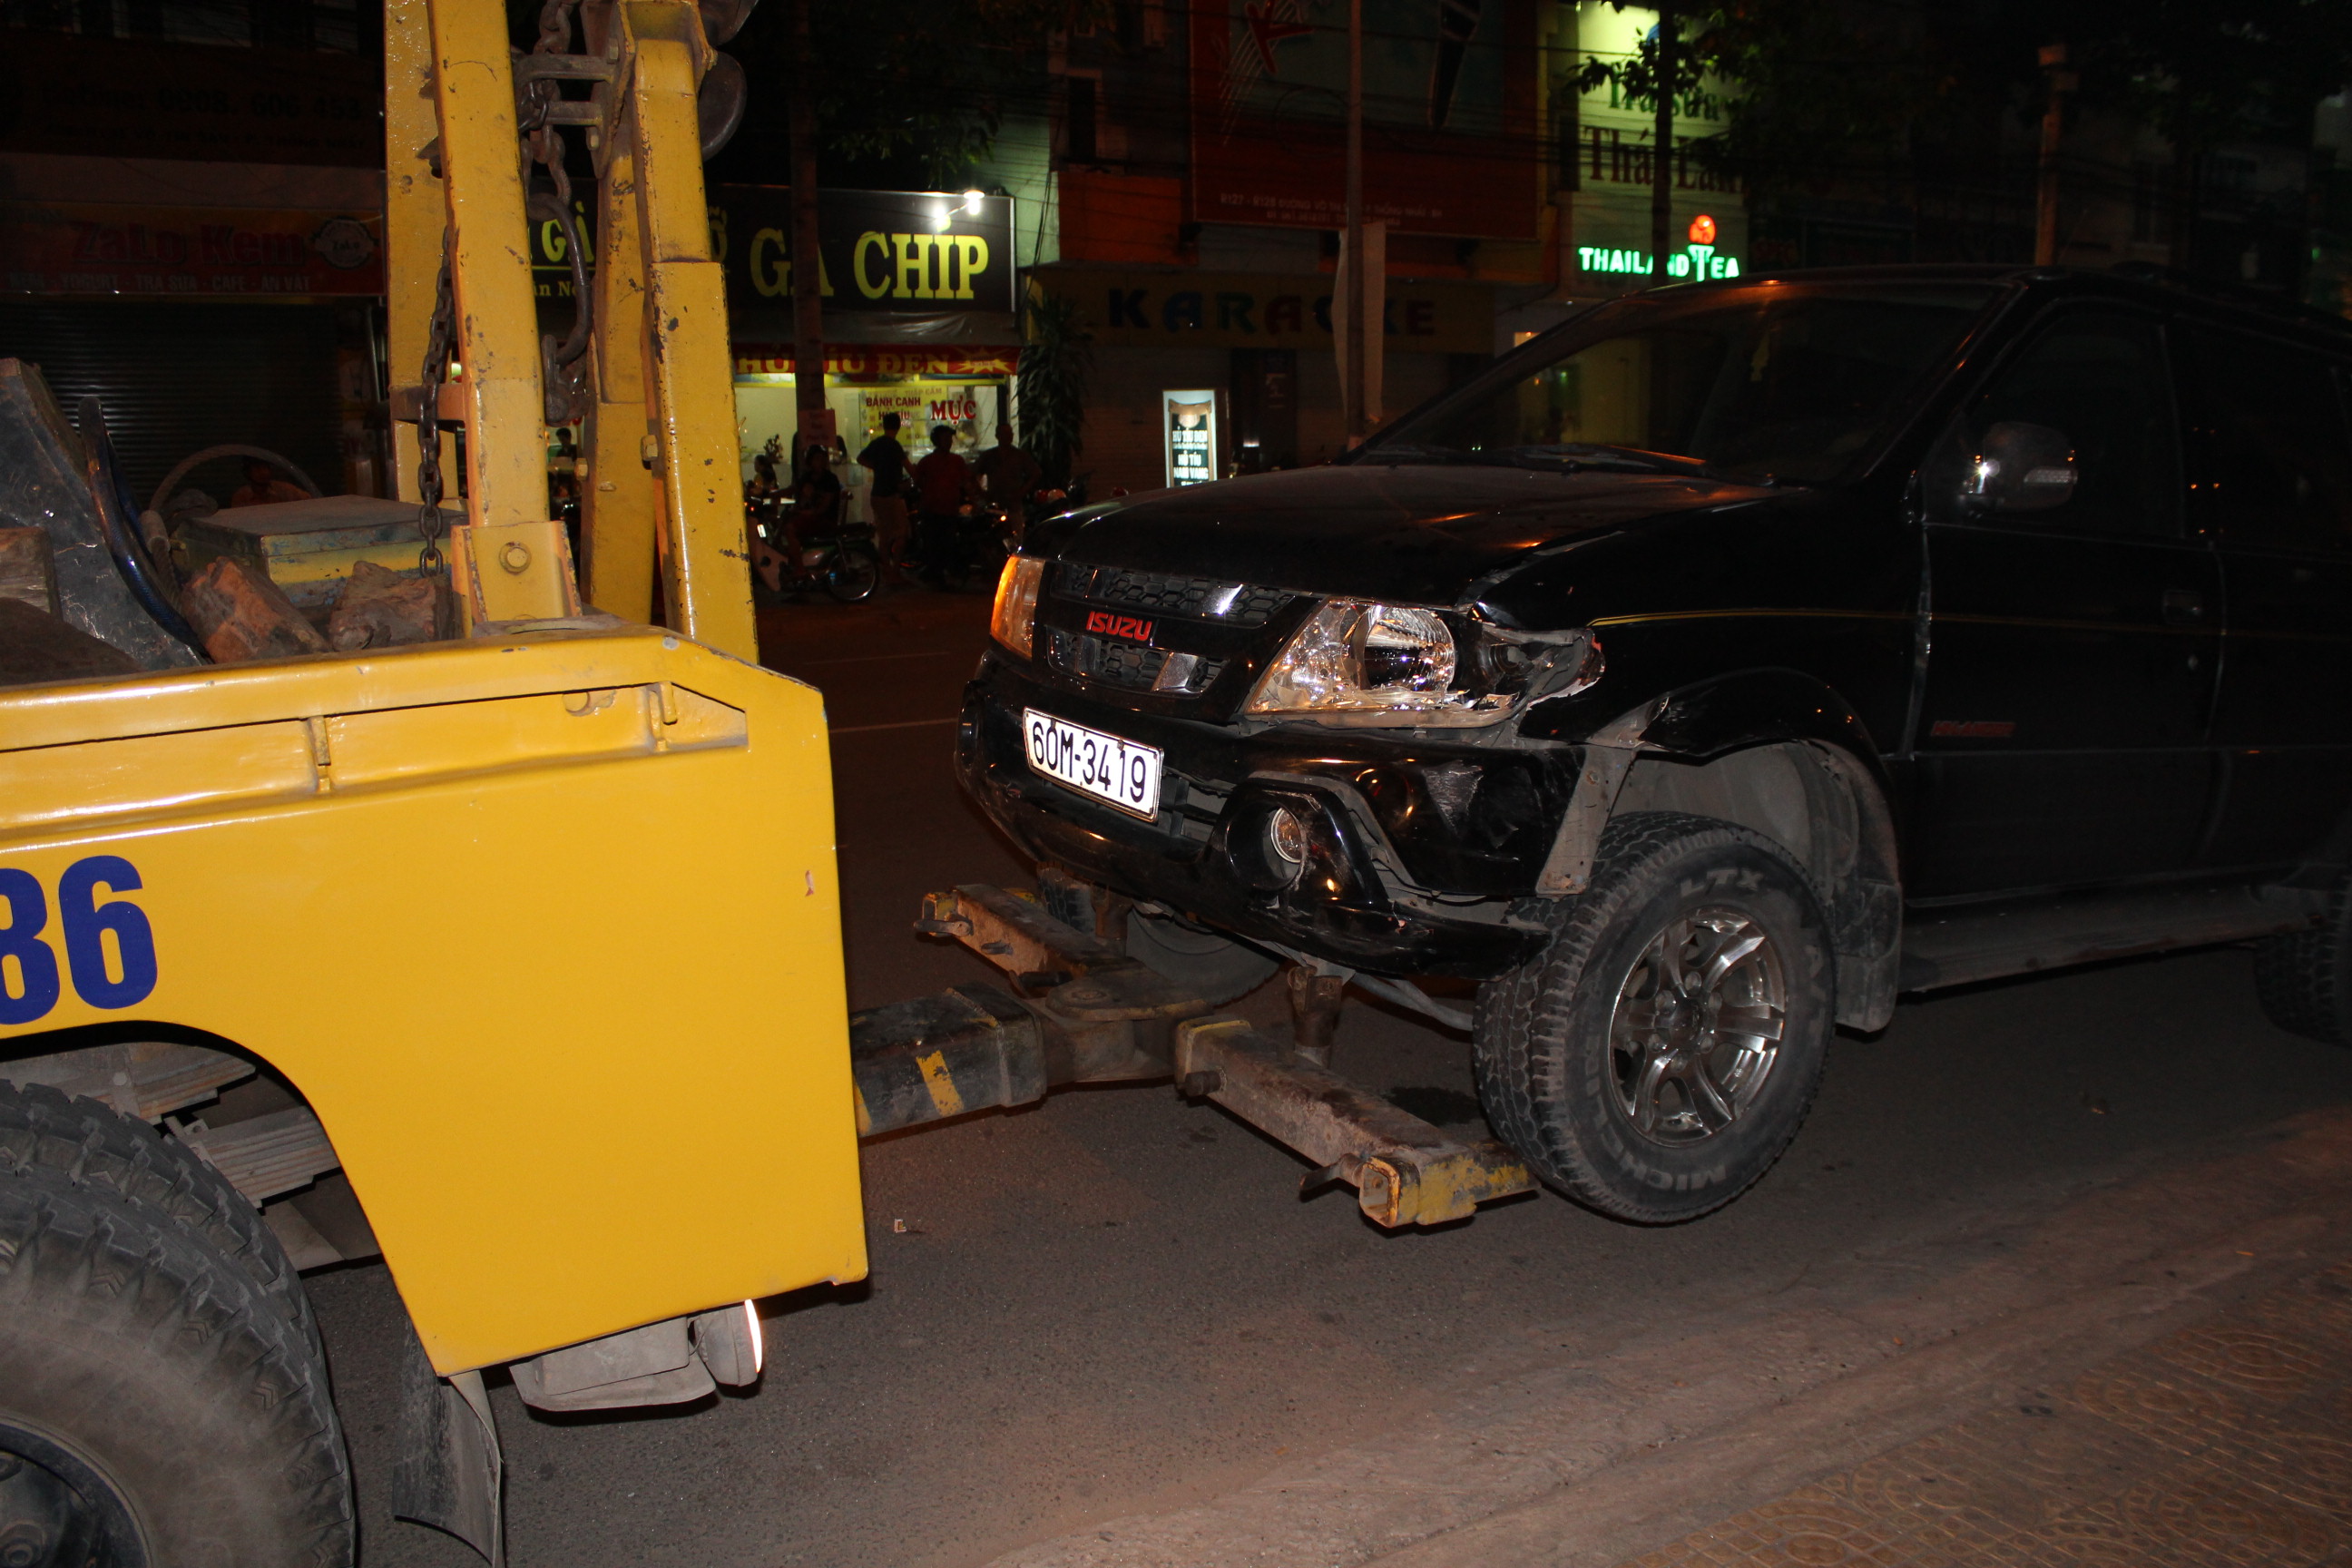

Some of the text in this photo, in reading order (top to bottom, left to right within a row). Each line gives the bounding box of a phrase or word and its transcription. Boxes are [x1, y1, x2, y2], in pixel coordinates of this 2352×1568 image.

[200, 223, 305, 266] Kem
[826, 347, 867, 375] ÍU
[896, 397, 921, 407] CANH
[931, 394, 976, 426] MỰC
[1085, 610, 1153, 642] ISUZU
[1032, 720, 1147, 804] 60M-3419
